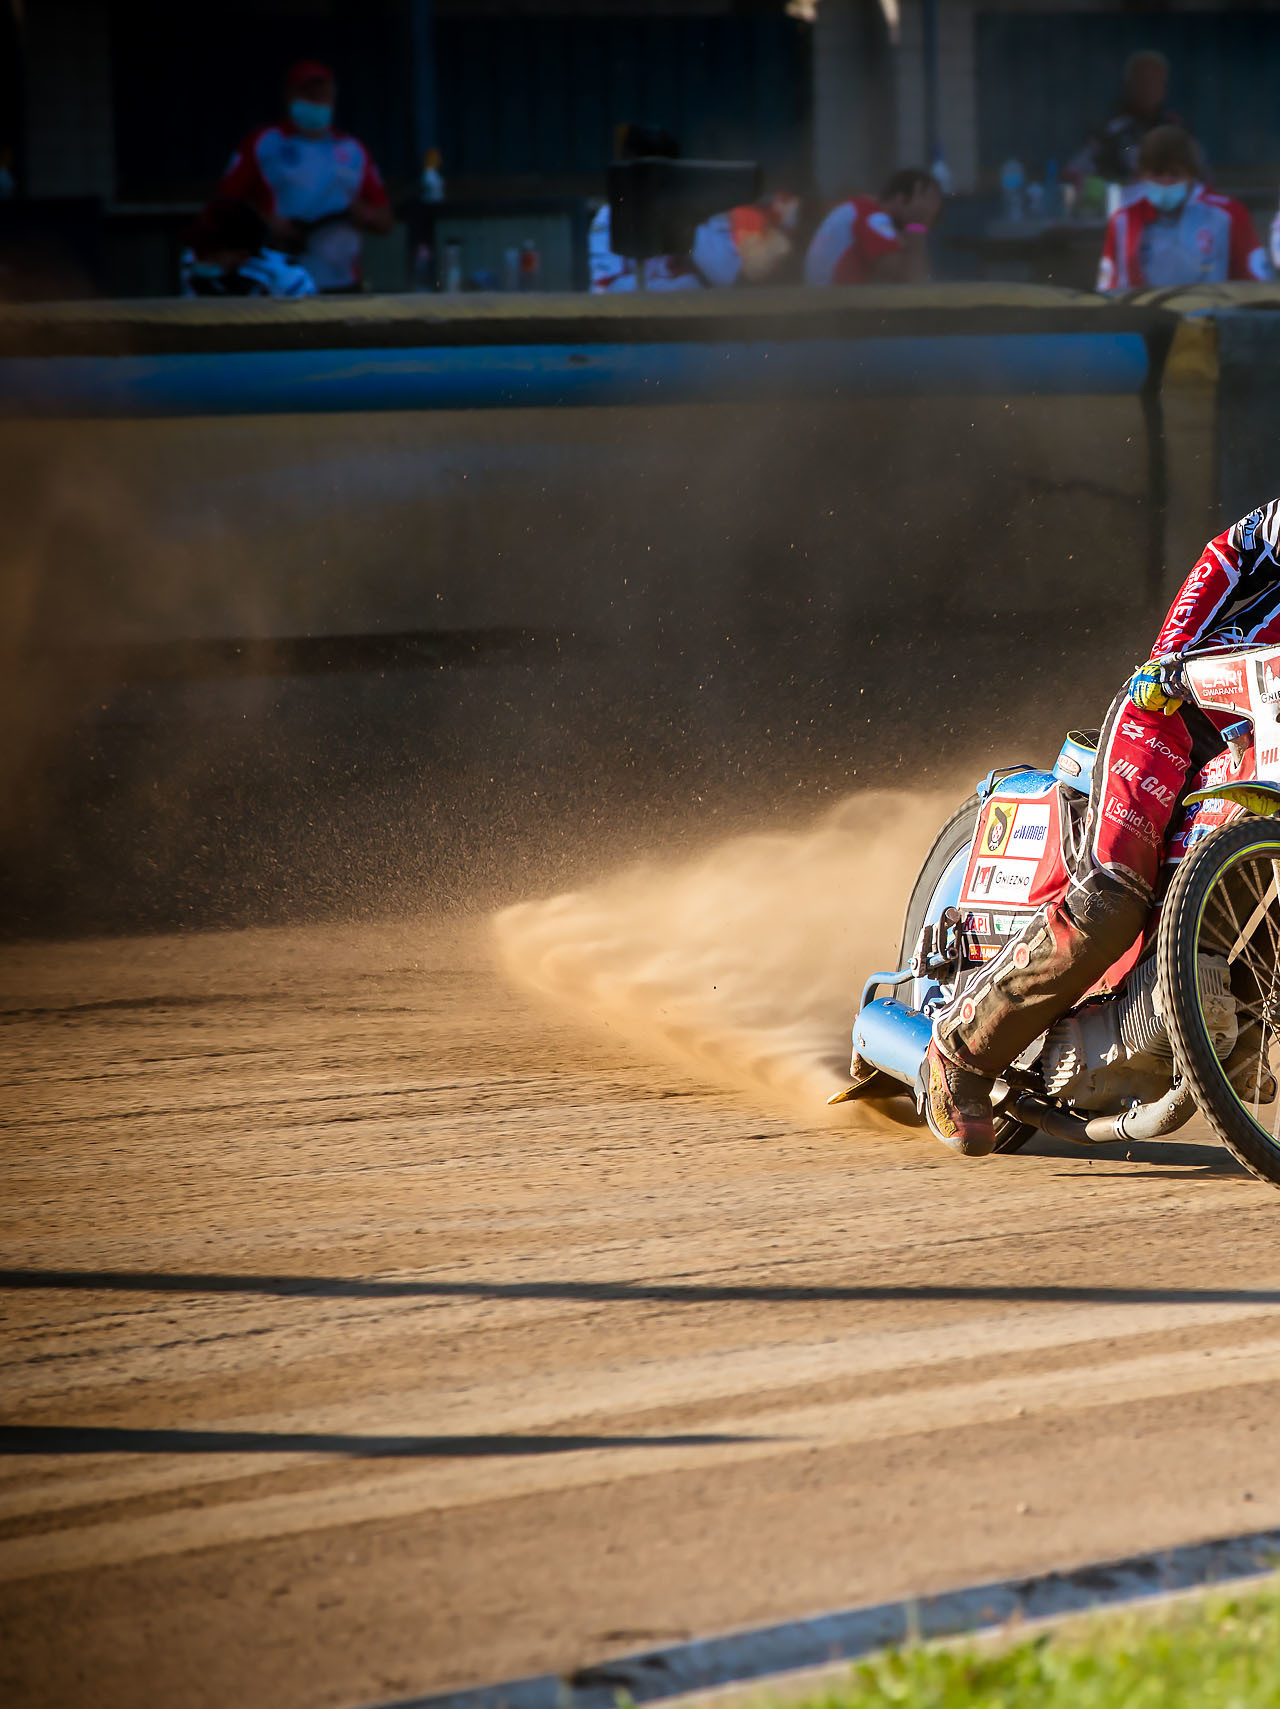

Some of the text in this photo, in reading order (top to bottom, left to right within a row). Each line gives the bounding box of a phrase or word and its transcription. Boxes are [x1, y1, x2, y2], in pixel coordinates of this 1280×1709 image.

[1145, 736, 1188, 772] AFORTI
[1110, 758, 1176, 808] HIL-GAZ
[1013, 824, 1048, 841] eWinner
[995, 871, 1030, 887] GNIEZNO
[963, 917, 988, 932] KAPI
